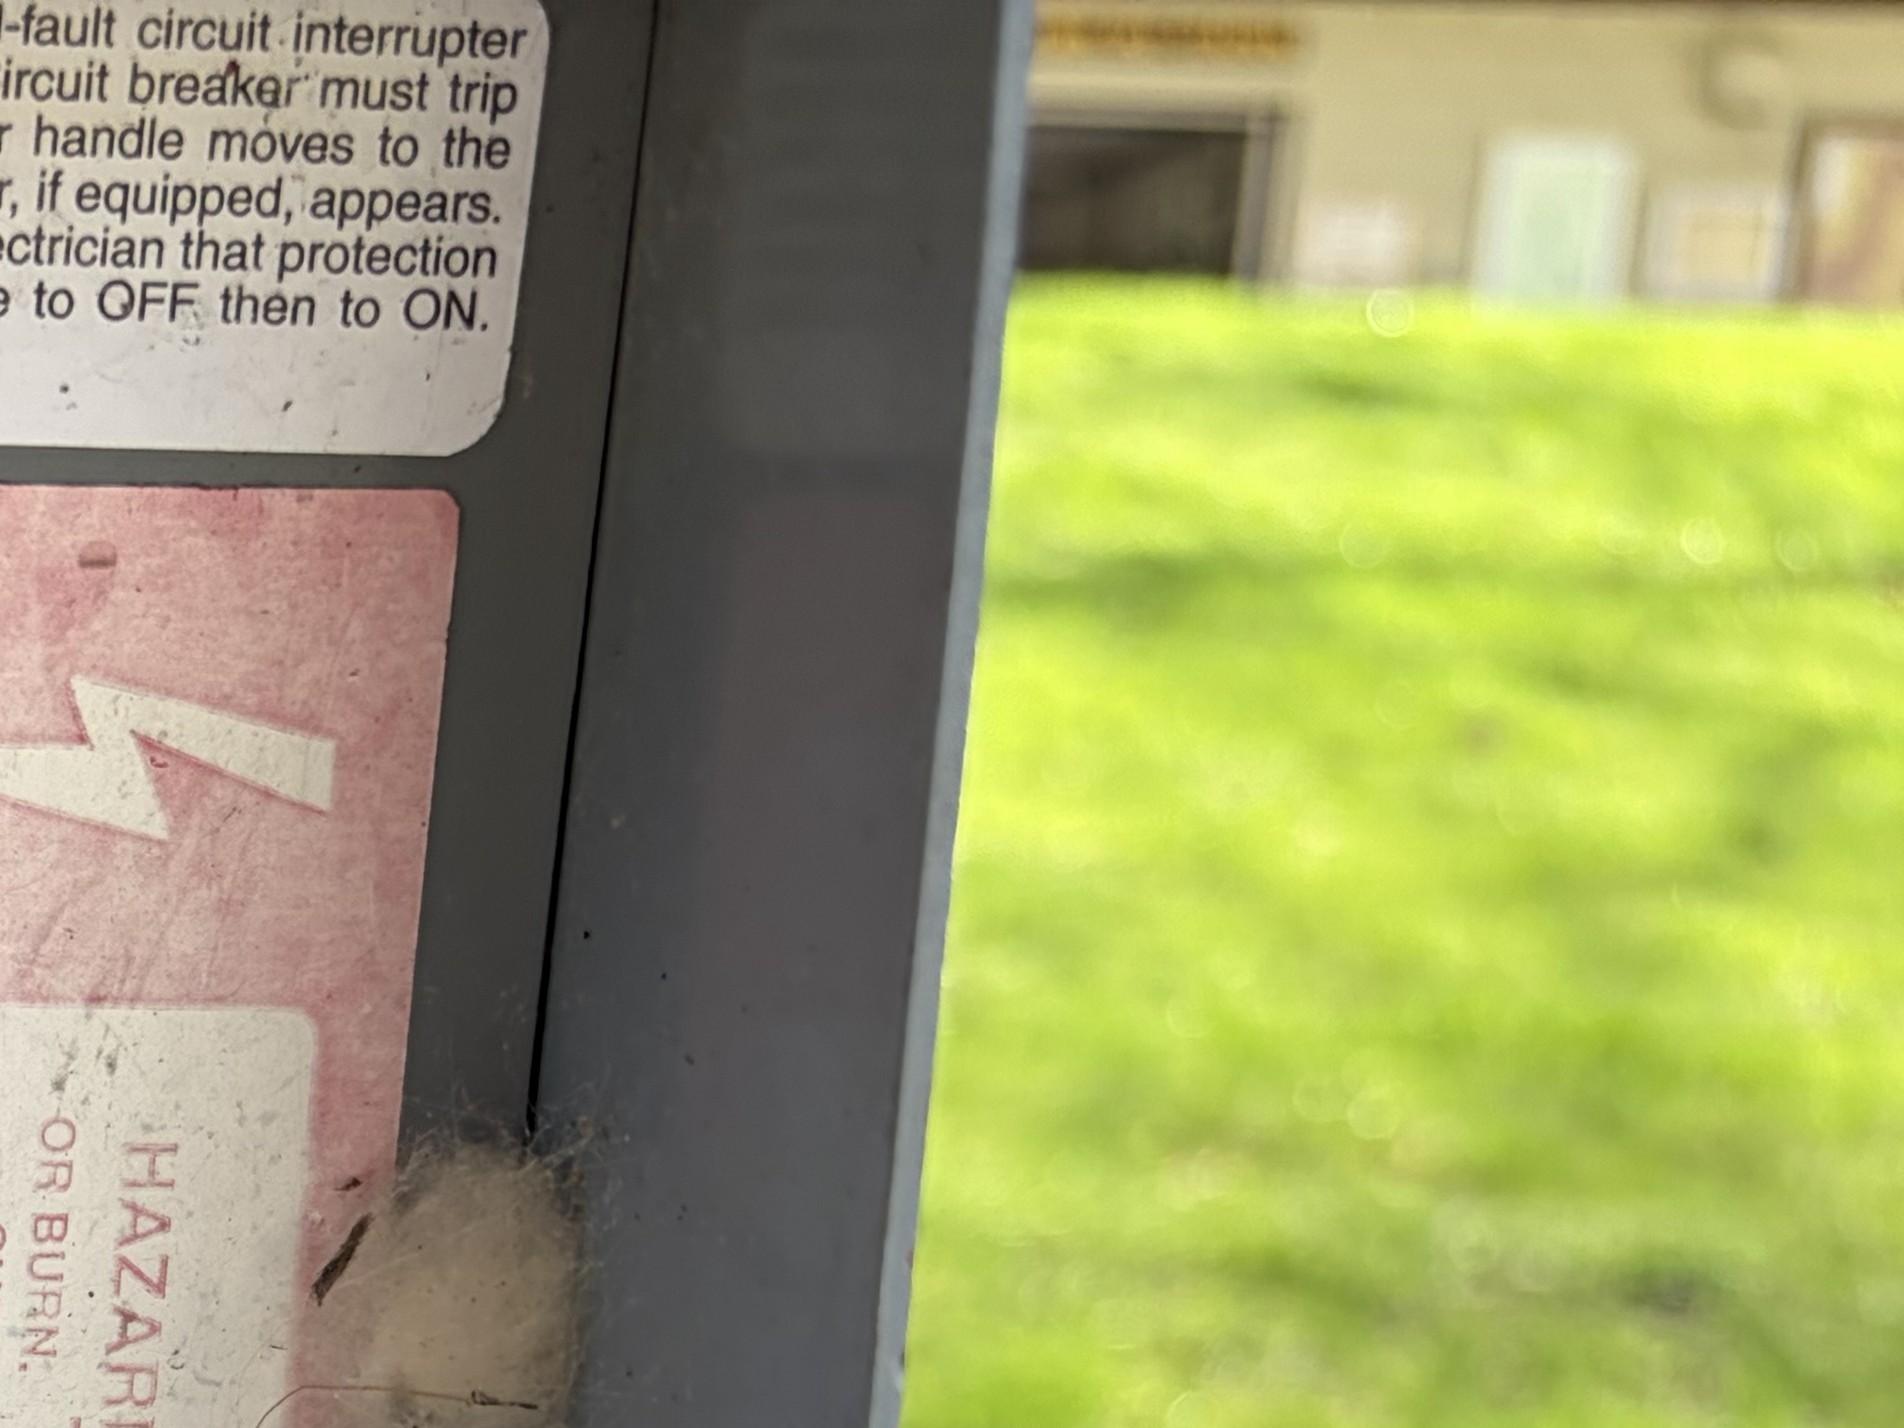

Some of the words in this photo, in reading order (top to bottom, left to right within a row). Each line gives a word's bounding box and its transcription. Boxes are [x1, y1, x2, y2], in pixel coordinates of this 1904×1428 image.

[138, 8, 271, 52] circuit
[294, 11, 527, 67] interrupter
[129, 59, 297, 109] breaker
[320, 72, 429, 111] must
[450, 72, 517, 125] trip
[34, 114, 184, 160] handle
[208, 129, 353, 165] moves
[379, 126, 418, 167] to
[444, 126, 510, 169] the
[37, 169, 64, 212] if
[75, 173, 292, 227] equipped,
[310, 187, 500, 231] appears.
[181, 229, 265, 271] that
[277, 235, 497, 283] protection
[34, 280, 74, 319] to
[97, 279, 200, 322] OFF
[220, 284, 315, 326] then
[341, 290, 380, 328] to
[404, 288, 489, 333] ON.
[35, 1116, 77, 1193] OR
[18, 1212, 69, 1372] BURN.
